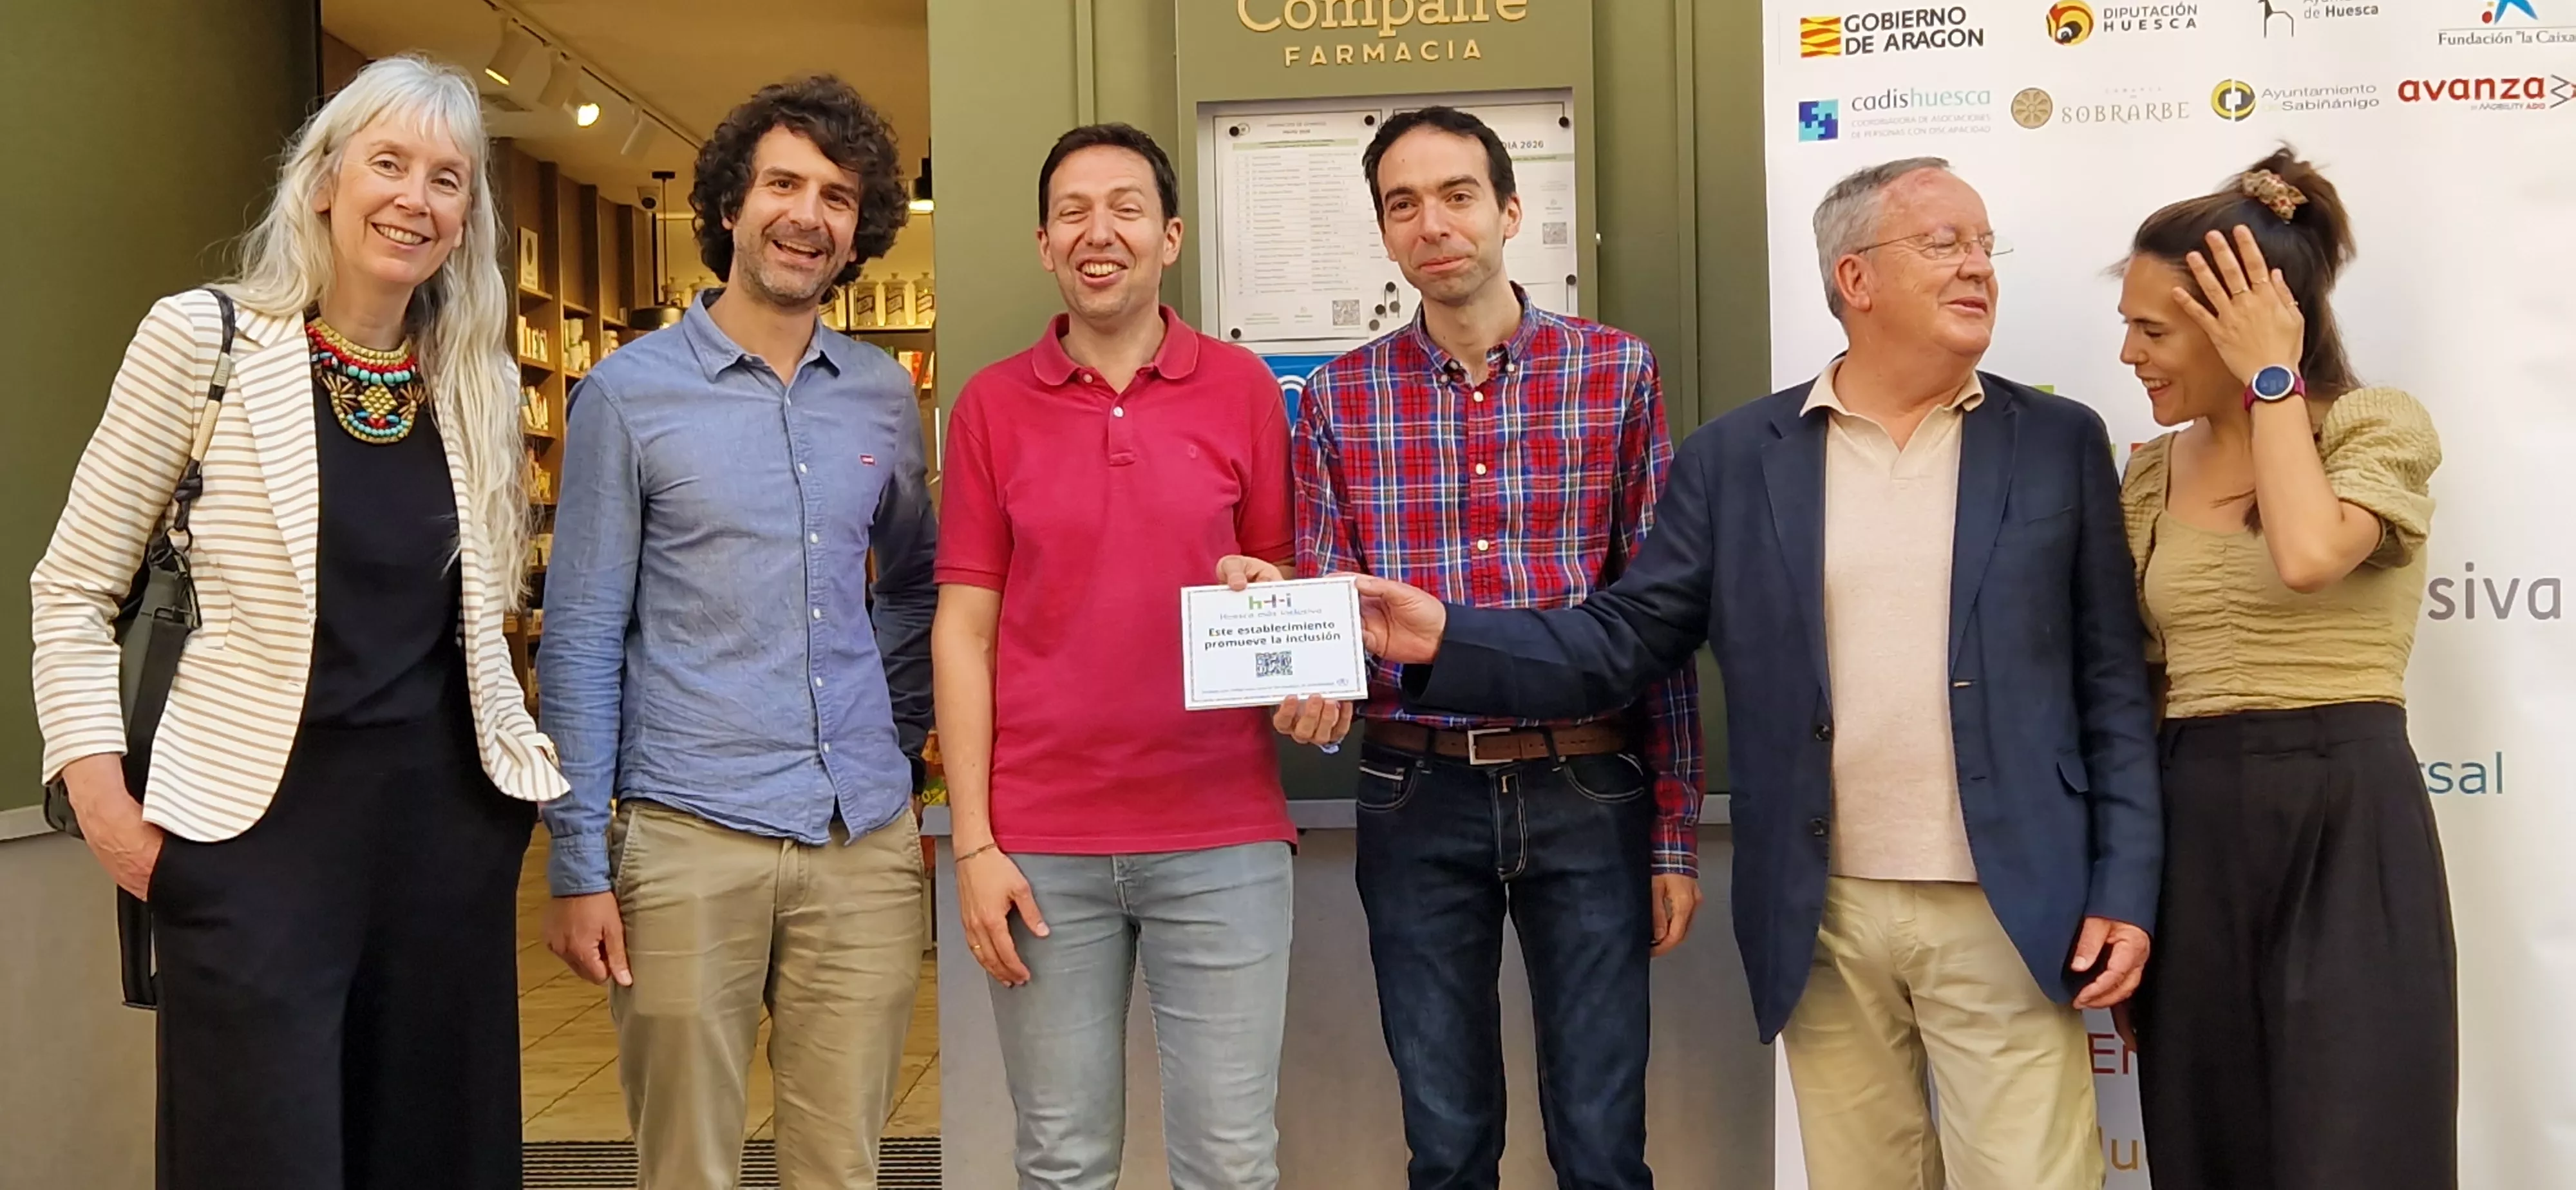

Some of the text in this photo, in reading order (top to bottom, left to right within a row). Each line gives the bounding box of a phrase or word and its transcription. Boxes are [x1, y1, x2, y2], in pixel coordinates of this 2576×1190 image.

[1844, 6, 1966, 32] GOBIERNO
[2103, 1, 2197, 19] DIPUTACIÓN
[2304, 5, 2378, 19] de Huesca
[2103, 18, 2197, 32] HUESCA
[1845, 28, 1984, 55] DE ARAGON
[2438, 32, 2512, 45] Fundación
[1285, 39, 1481, 67] FARMACIA
[2261, 84, 2376, 100] Ayuntamiento
[2398, 77, 2545, 102] avanza
[1852, 88, 1990, 111] cadishuesca
[2282, 98, 2379, 111] Sabiñánigo
[2062, 102, 2190, 124] SOBRARBE
[1209, 621, 1335, 637] Este establecimiento
[1205, 632, 1341, 650] promueve la inclusión
